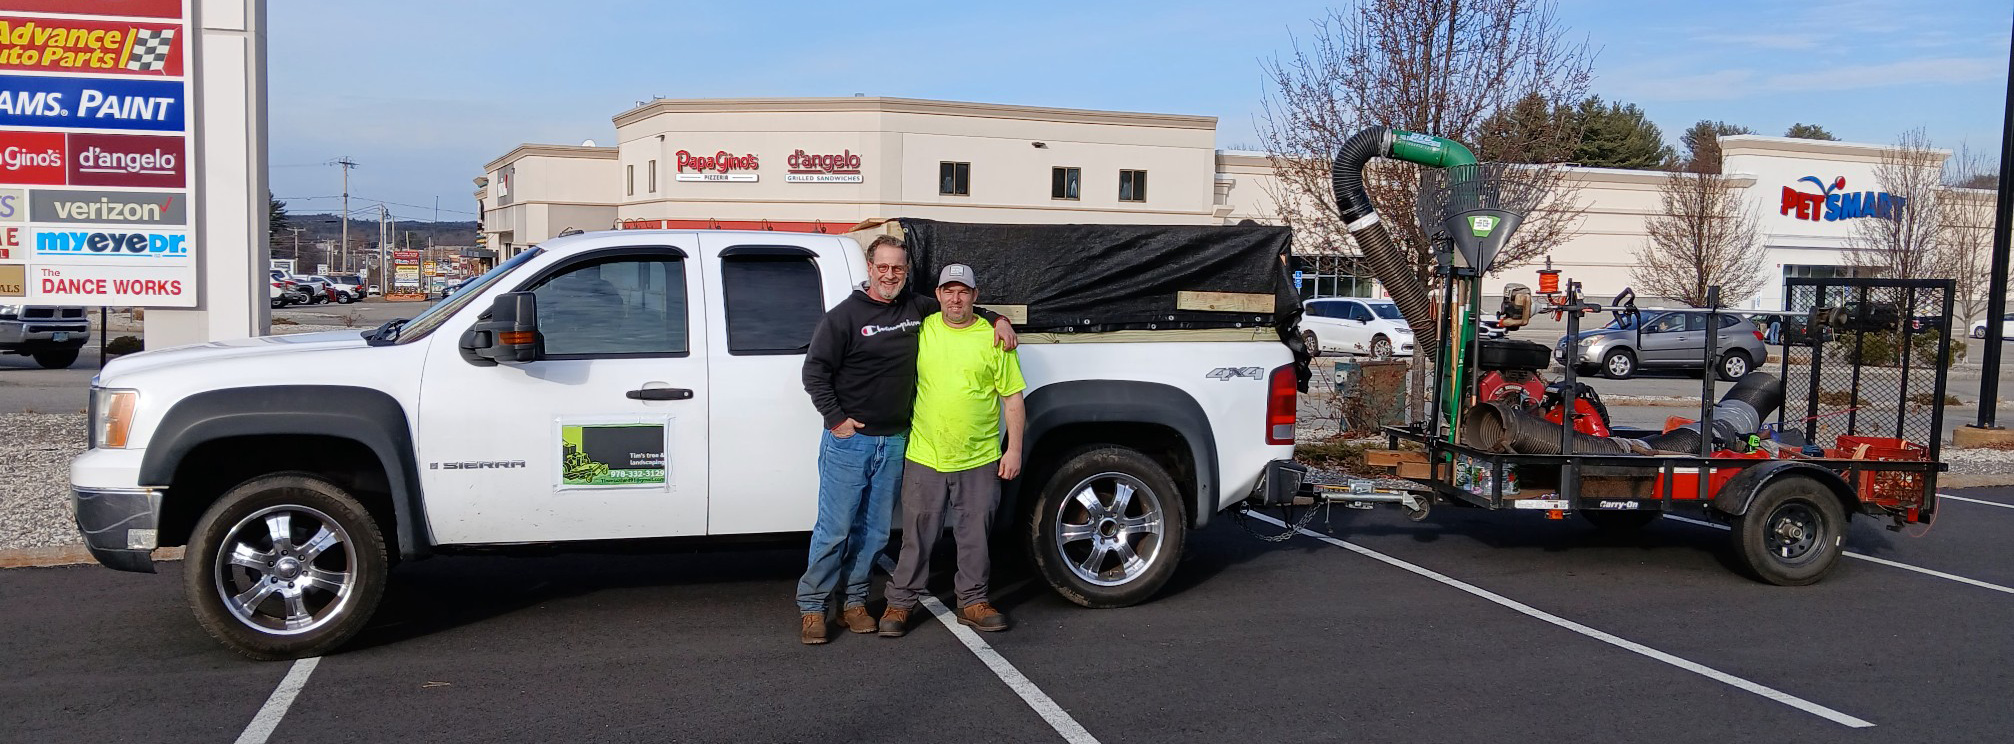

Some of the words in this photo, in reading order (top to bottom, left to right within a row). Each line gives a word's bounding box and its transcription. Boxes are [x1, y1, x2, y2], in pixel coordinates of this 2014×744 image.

[41, 47, 116, 69] Parts
[77, 89, 175, 121] PAINT
[79, 146, 175, 172] d'angelo
[787, 149, 861, 173] d'angelo
[54, 198, 160, 221] verizon
[41, 268, 60, 277] The
[42, 278, 107, 295] DANCE
[113, 279, 182, 295] WORKS
[861, 319, 921, 336] Champion
[443, 460, 526, 469] SIERRA
[1599, 500, 1639, 510] Carry-On
